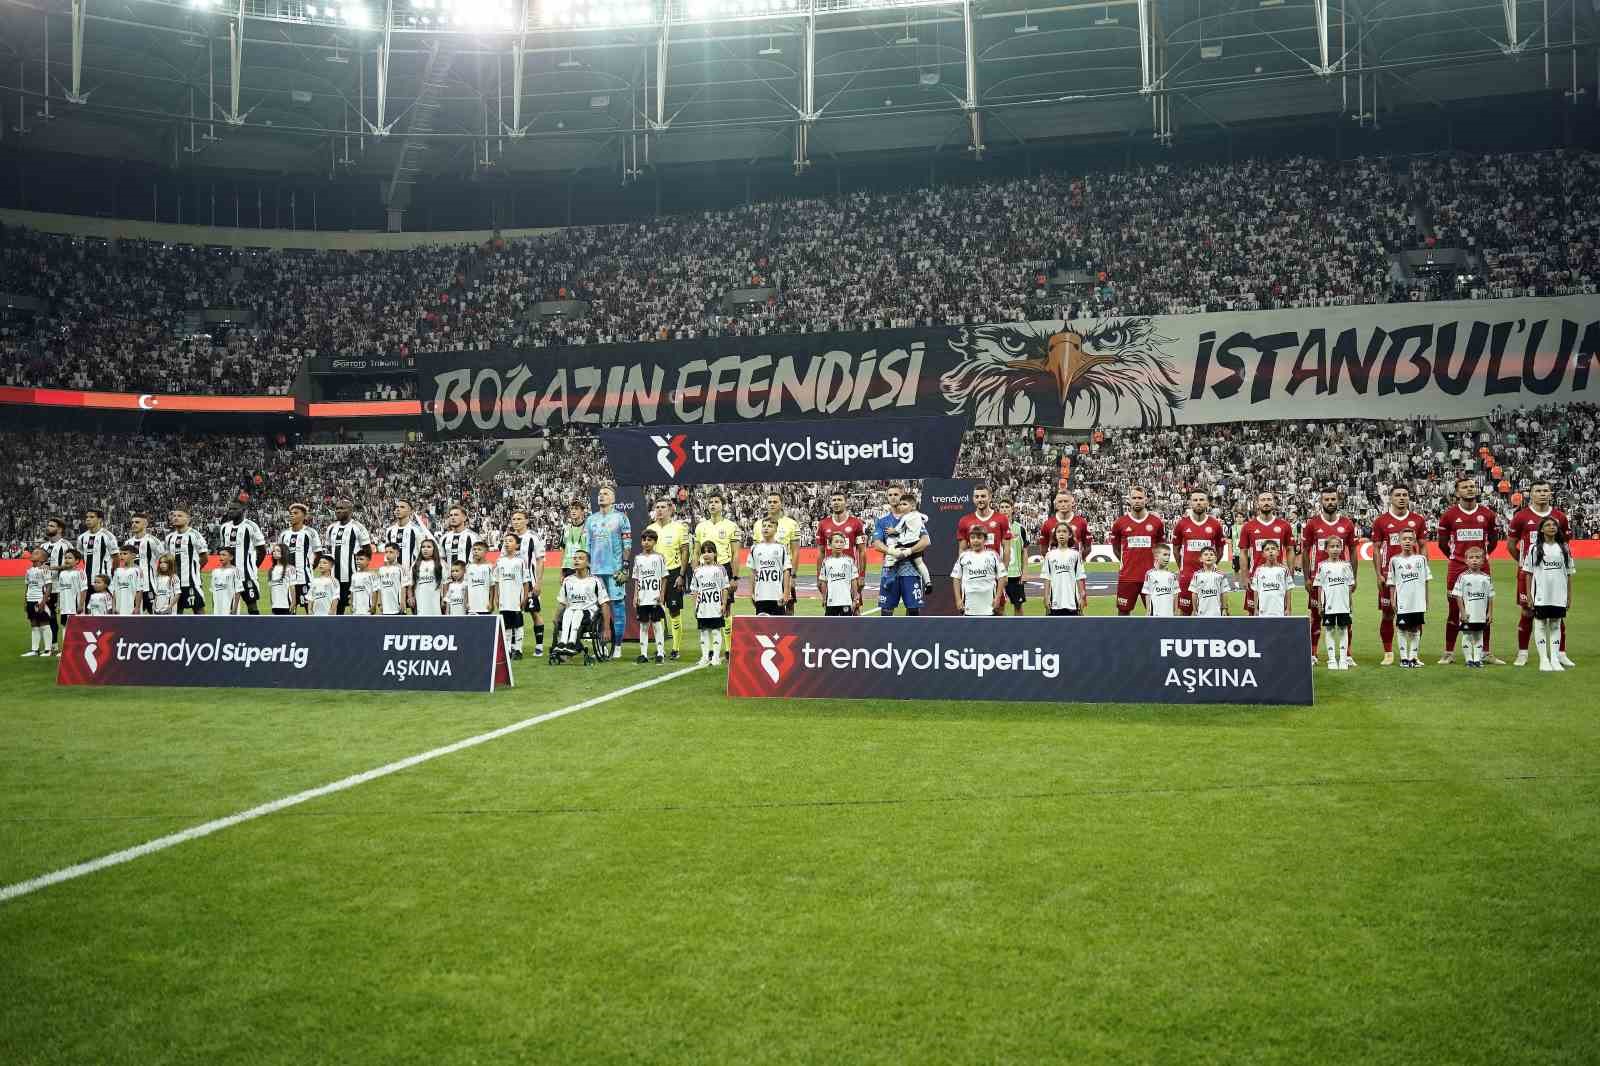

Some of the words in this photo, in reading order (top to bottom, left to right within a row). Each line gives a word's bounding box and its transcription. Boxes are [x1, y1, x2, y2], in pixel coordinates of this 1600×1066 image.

[434, 363, 664, 432] BOĞAZIN
[673, 341, 925, 424] EFENDİSİ
[692, 437, 812, 466] trendyol
[815, 437, 914, 465] SüperLig
[528, 598, 535, 609] 2
[912, 588, 922, 600] 13
[116, 637, 220, 666] trendyol
[222, 641, 309, 668] SüperLig
[383, 634, 458, 651] FUTBOL
[1160, 638, 1262, 658] FUTBOL
[383, 659, 452, 681] AŞKINA
[801, 642, 940, 675] trendyol
[944, 647, 1060, 679] SüperLig
[1164, 668, 1258, 693] AŞKINA
